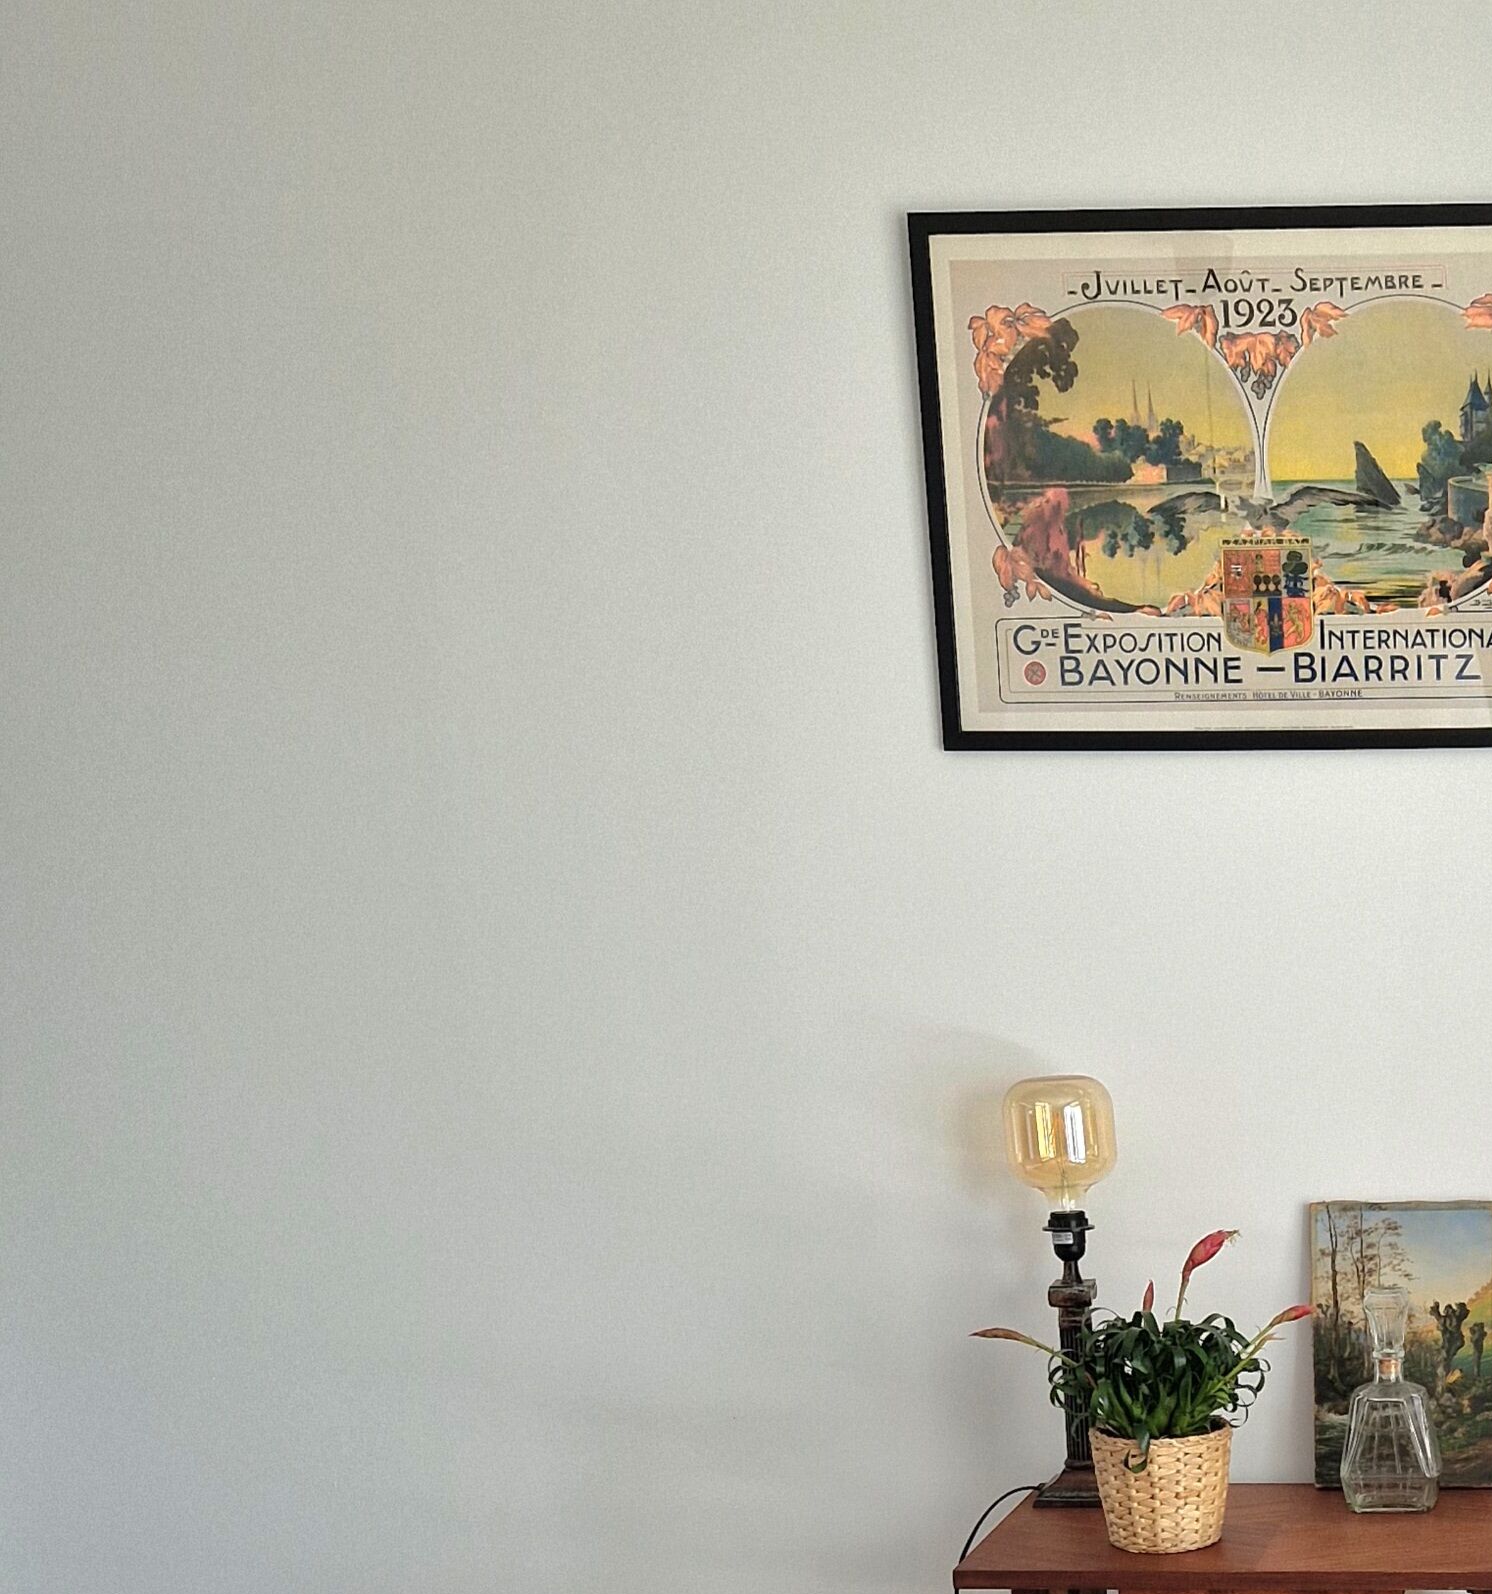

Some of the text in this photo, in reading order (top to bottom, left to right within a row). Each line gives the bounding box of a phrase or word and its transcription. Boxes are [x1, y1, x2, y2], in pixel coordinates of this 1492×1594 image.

[1220, 298, 1299, 329] 1923
[1059, 652, 1482, 687] BAYONNE BIARRITZ
